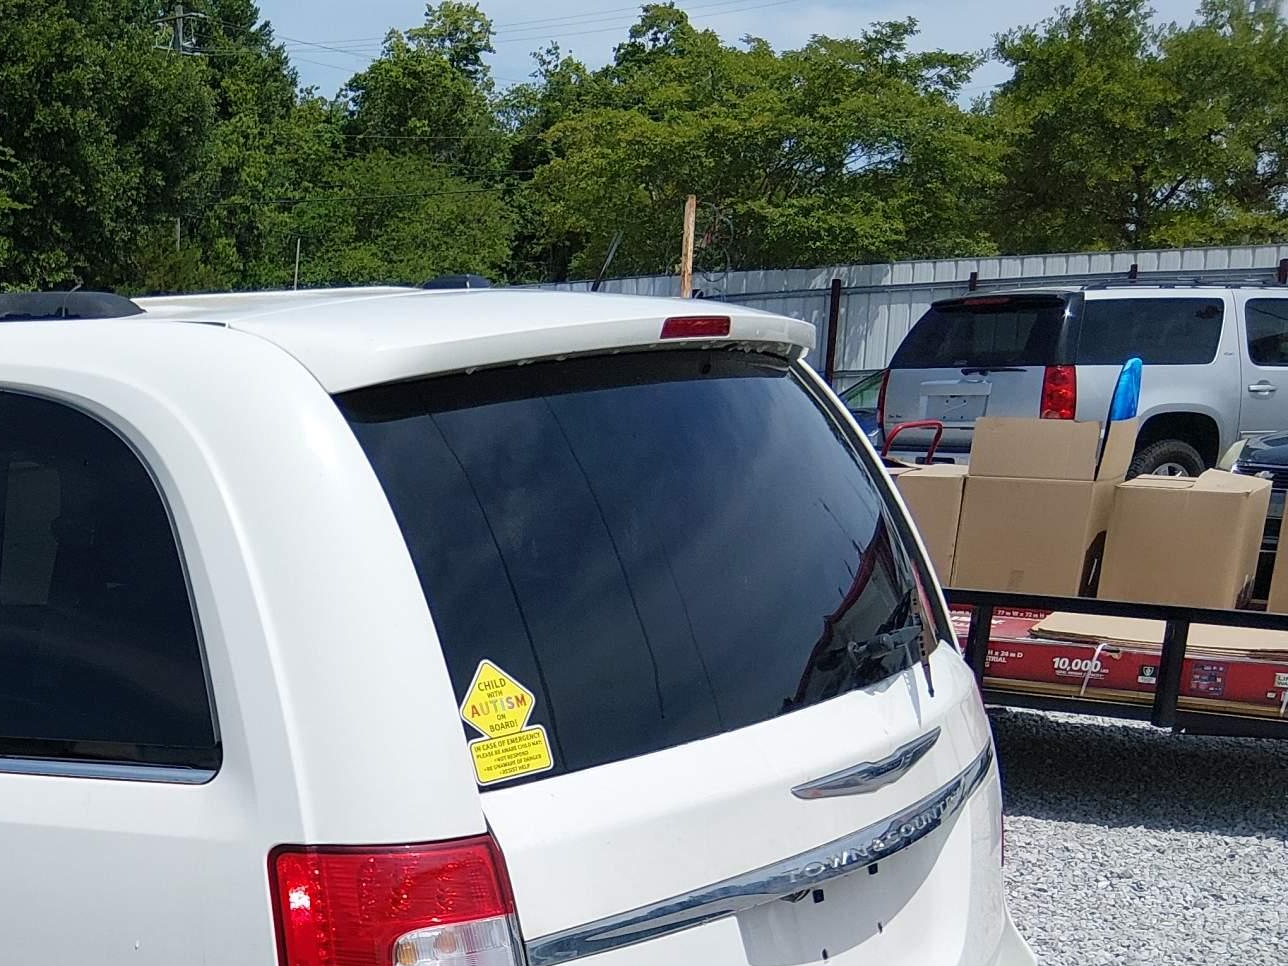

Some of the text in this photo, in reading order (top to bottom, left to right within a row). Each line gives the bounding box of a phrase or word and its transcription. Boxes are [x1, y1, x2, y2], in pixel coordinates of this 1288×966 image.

[986, 655, 1007, 663] TRIAL
[1052, 657, 1102, 673] 10,000
[477, 677, 507, 692] CHILD
[487, 690, 504, 699] WITH
[471, 694, 527, 718] AUTISM
[497, 713, 506, 721] ON
[489, 720, 519, 733] BOARD!
[482, 742, 496, 751] CASE
[507, 732, 541, 745] EMERGENCY
[784, 775, 969, 884] TOWN & COUNTRY
